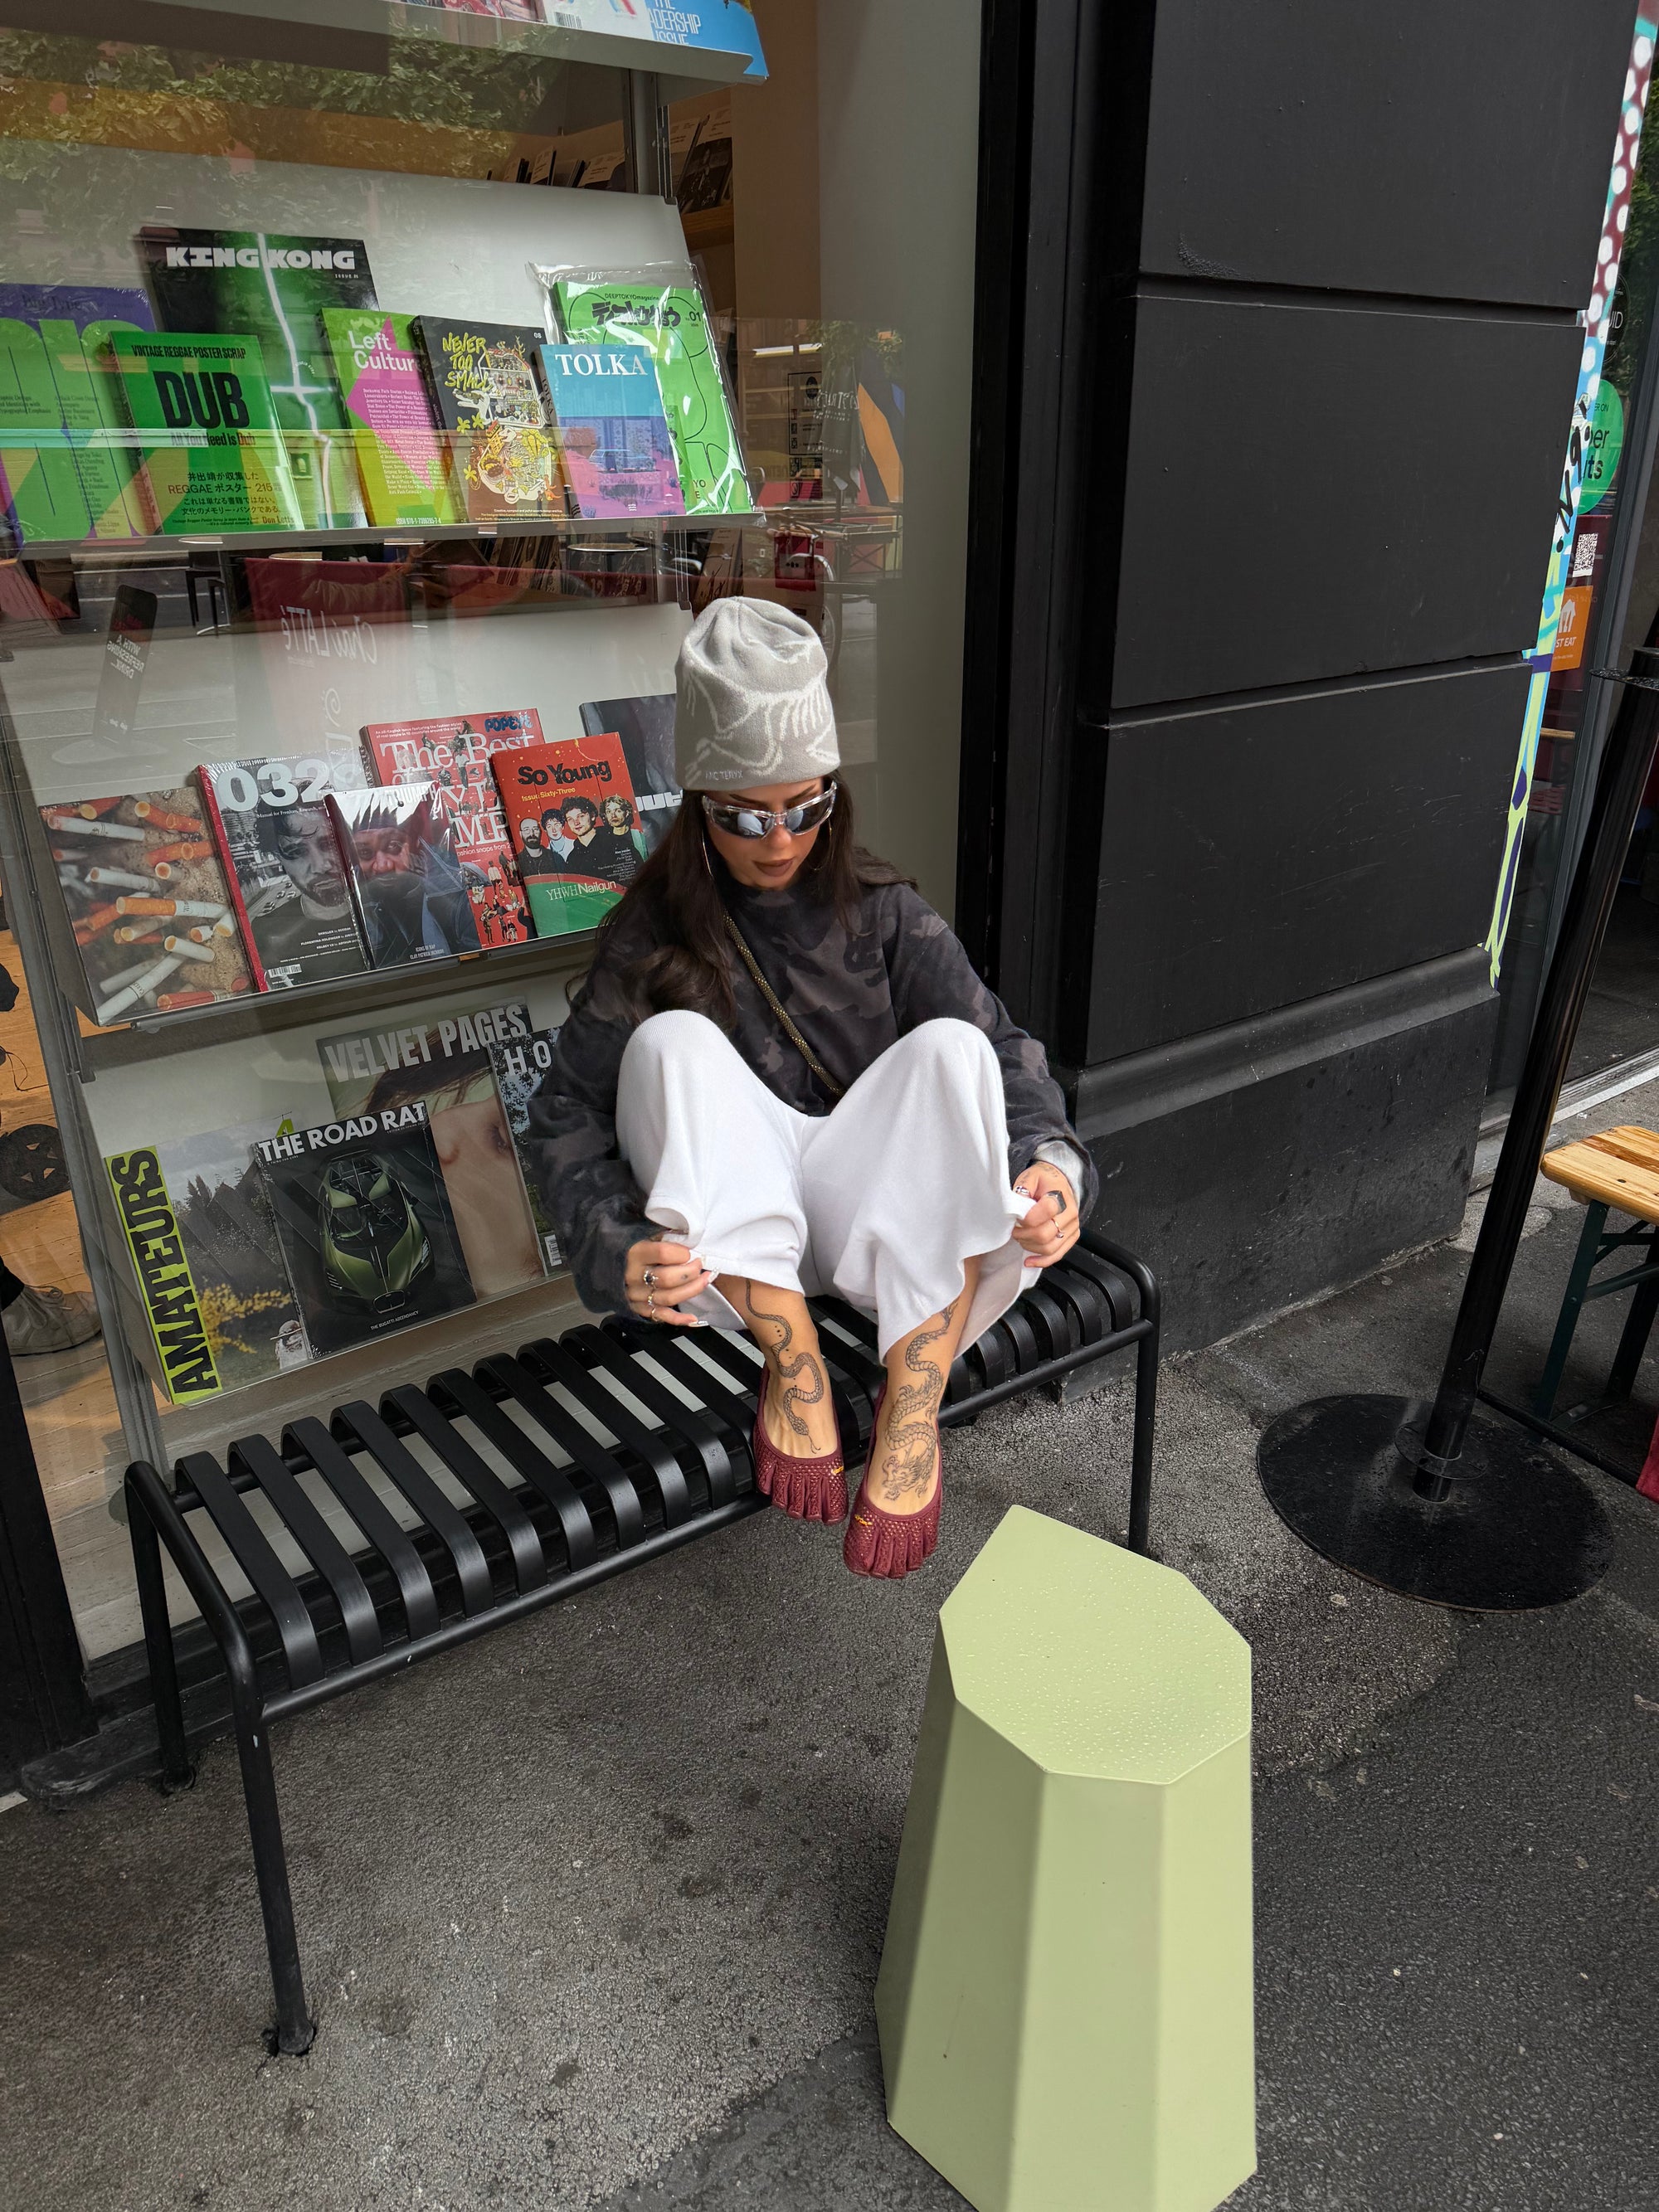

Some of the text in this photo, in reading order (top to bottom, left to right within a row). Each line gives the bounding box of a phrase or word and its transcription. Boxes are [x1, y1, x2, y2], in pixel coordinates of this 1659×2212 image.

[648, 7, 701, 34] ADERSHIP
[166, 246, 356, 270] KING KONG
[688, 311, 702, 322] 01
[348, 330, 392, 351] Left
[442, 332, 486, 354] NEVER
[131, 345, 246, 359] VINTAGE REGGAE POSTER SCRAP
[450, 352, 474, 372] TOO
[555, 353, 648, 376] TOLKA
[153, 371, 250, 430] DUB
[1600, 403, 1610, 412] ON
[183, 432, 203, 446] You
[202, 432, 227, 447] Need
[237, 431, 256, 446] Dub
[1588, 428, 1609, 450] er
[168, 484, 213, 494] REGGAE
[215, 484, 251, 493] ポスター
[262, 516, 275, 524] Don
[1555, 636, 1577, 649] ST EAT
[380, 739, 453, 774] The
[459, 729, 534, 766] Best
[518, 761, 613, 785] So Young
[539, 787, 576, 800] Sixty-Three
[477, 846, 493, 855] snaps
[577, 881, 617, 895] Nailgun
[324, 1004, 528, 1083] VELVET PAGES
[258, 1134, 305, 1162] THE
[306, 1116, 378, 1150] ROAD
[380, 1101, 426, 1131] RAT
[110, 1150, 221, 1395] AMATEURS
[378, 1318, 395, 1328] BUGATTI
[395, 1310, 419, 1323] ASCENDANCY
